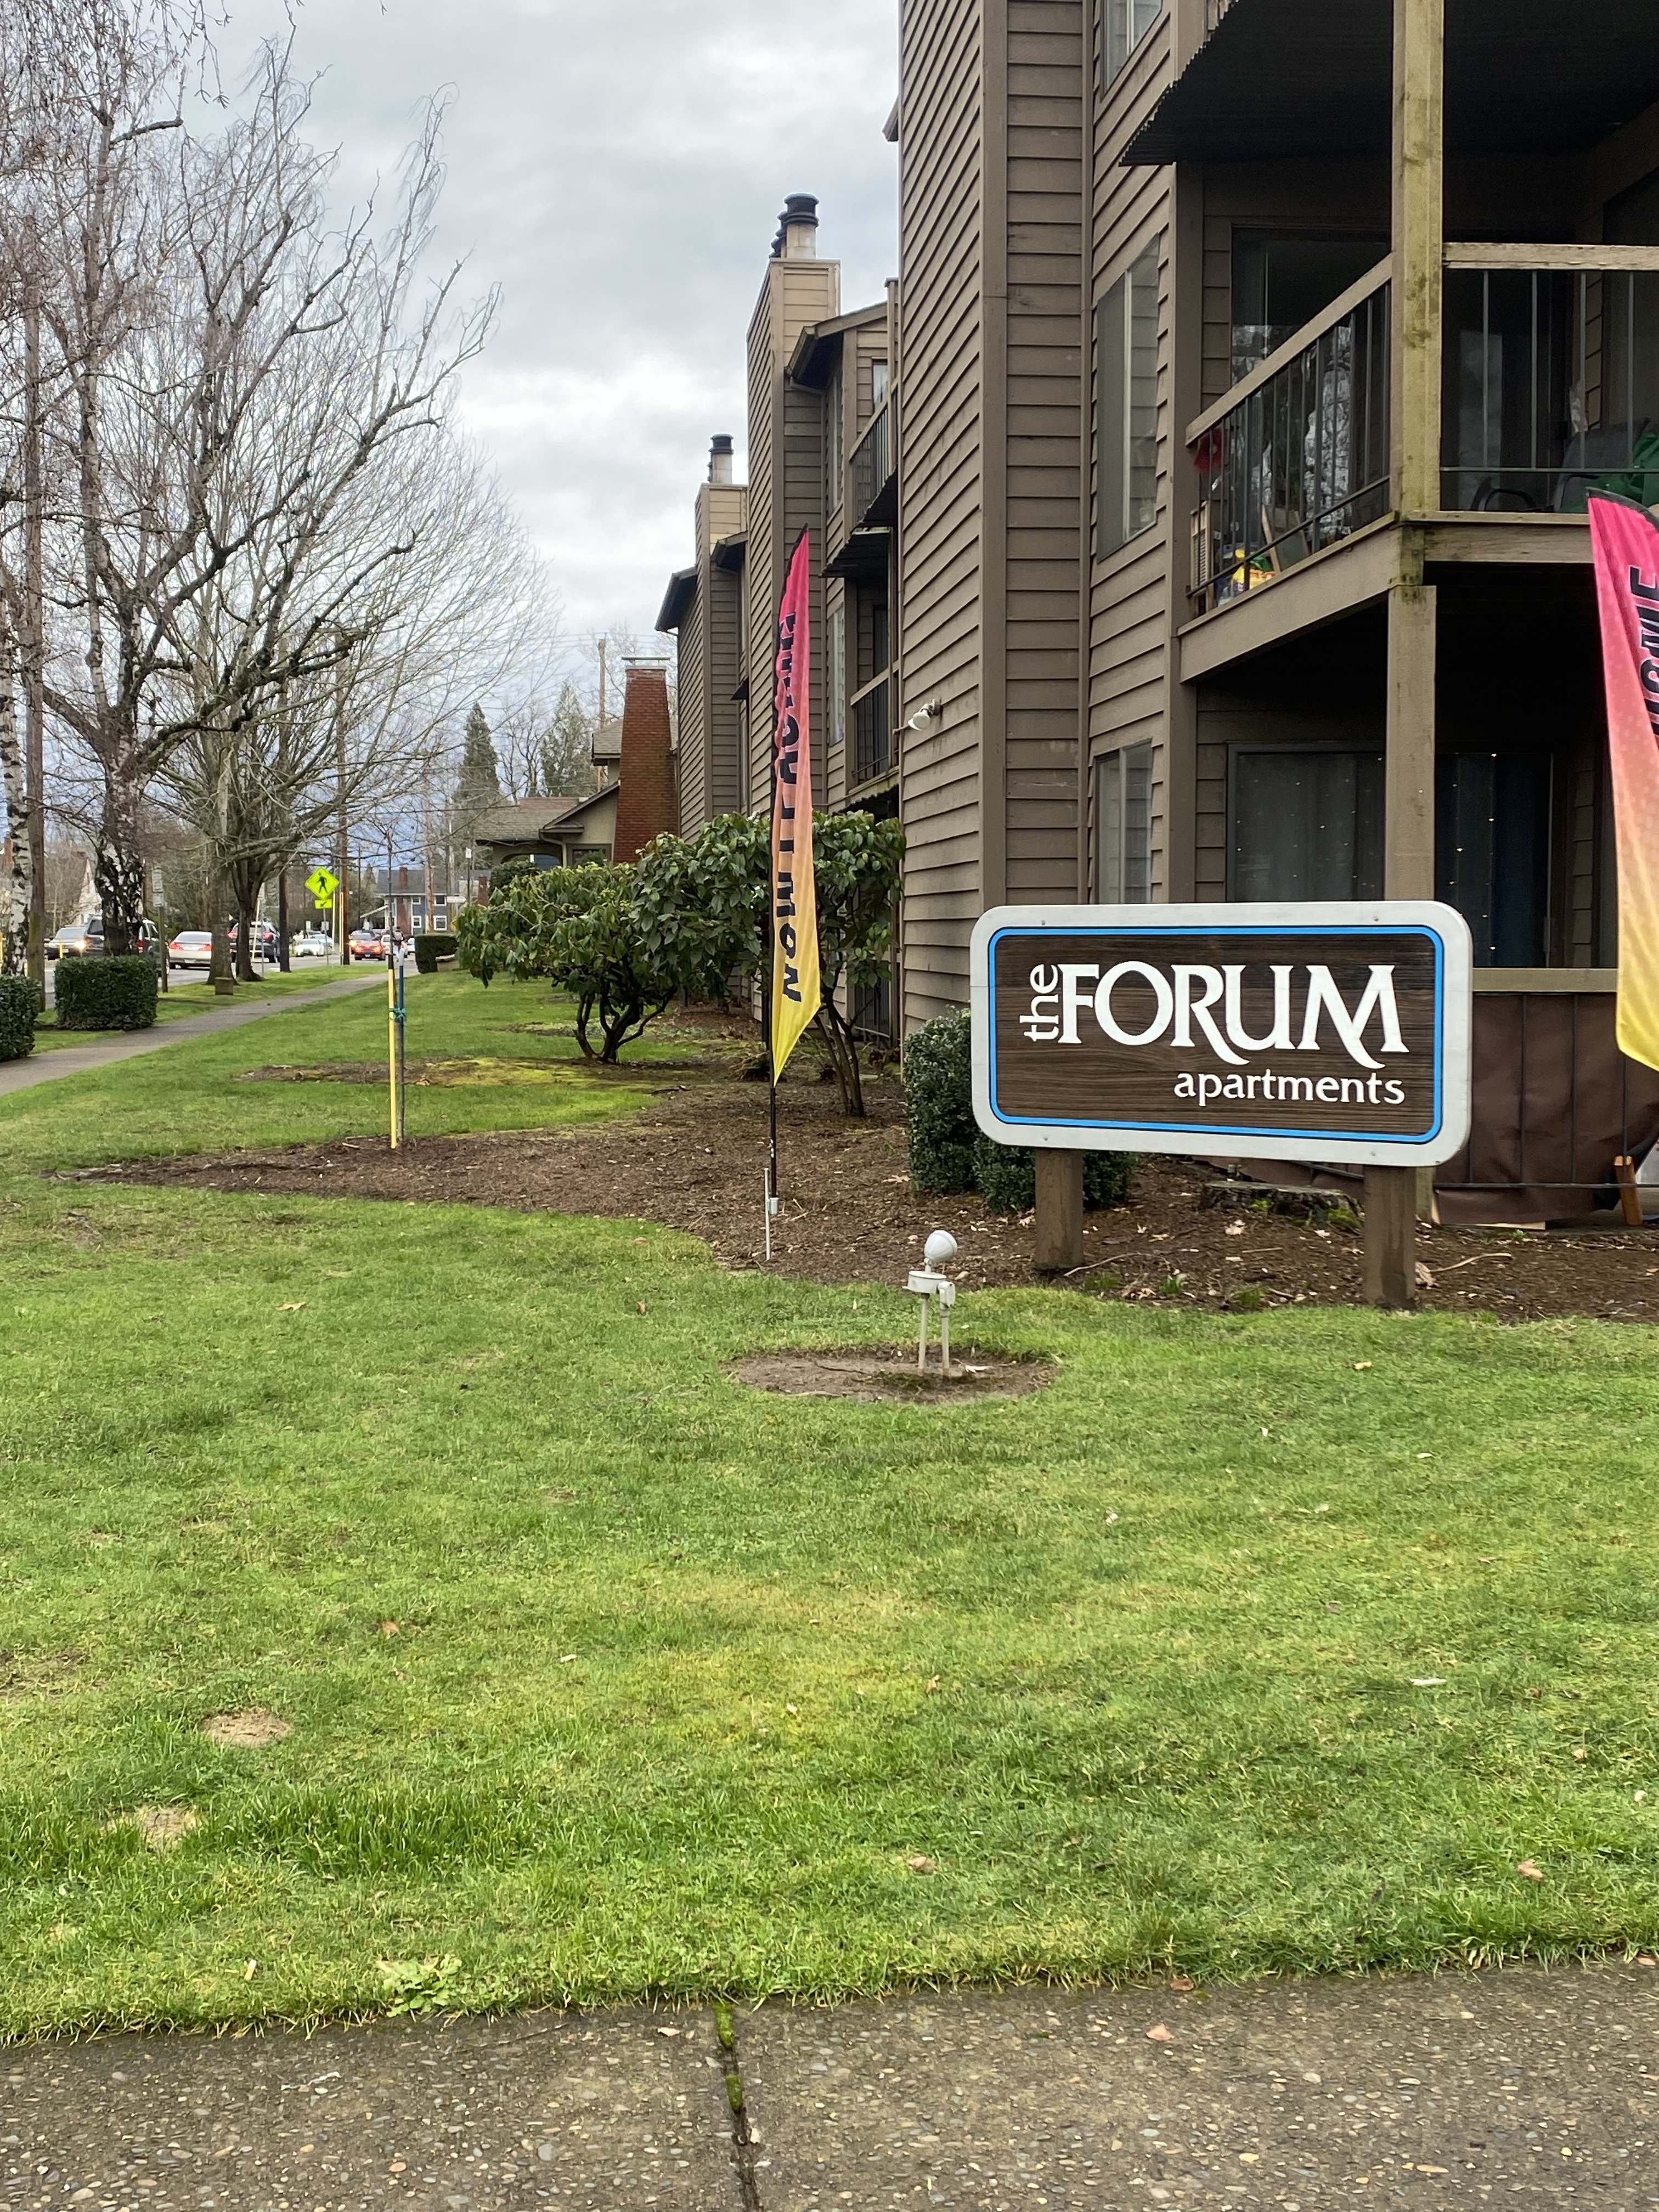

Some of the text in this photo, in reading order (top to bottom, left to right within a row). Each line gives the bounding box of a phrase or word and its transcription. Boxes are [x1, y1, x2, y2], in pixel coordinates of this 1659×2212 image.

[1019, 960, 1409, 1069] the FORUM
[1173, 1068, 1406, 1107] apartments
